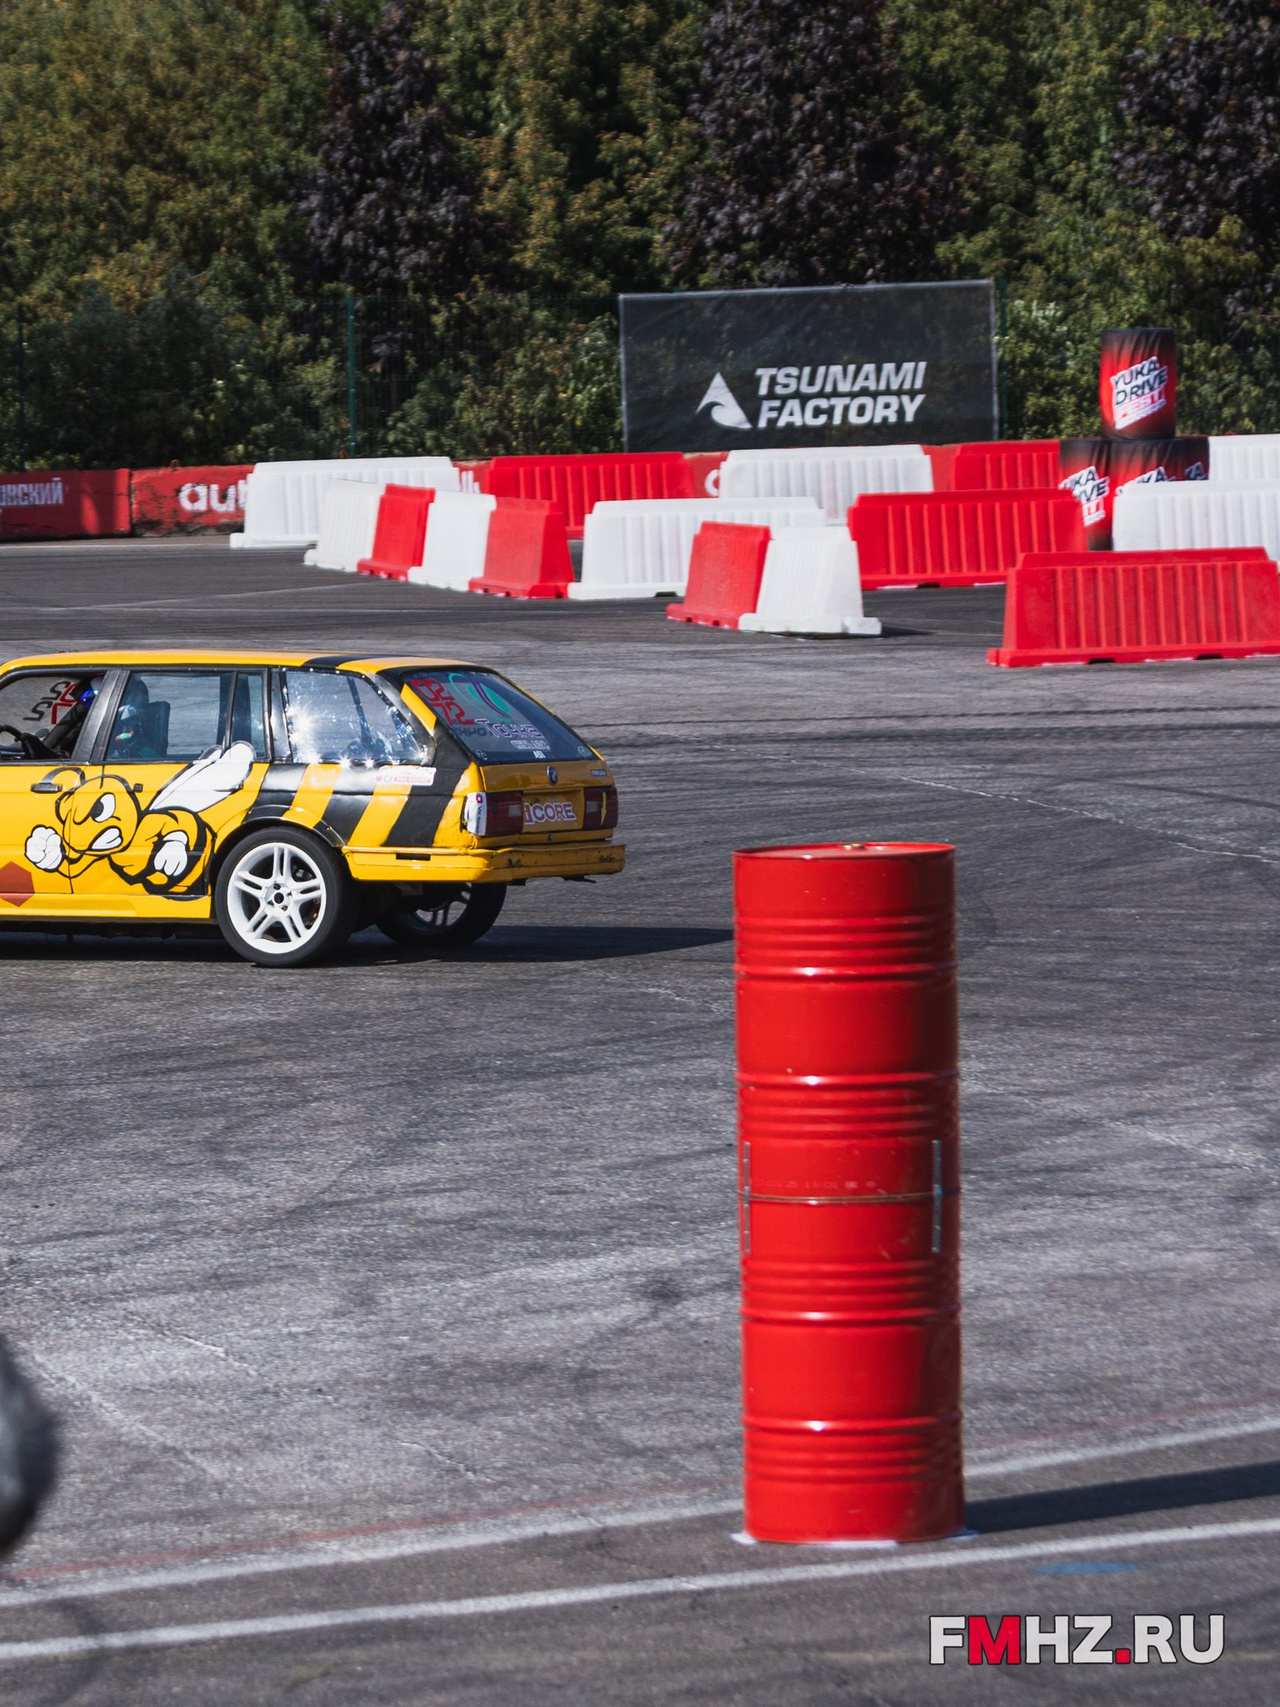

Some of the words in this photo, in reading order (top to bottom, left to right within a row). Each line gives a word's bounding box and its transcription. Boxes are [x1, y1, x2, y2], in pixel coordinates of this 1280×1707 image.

[755, 361, 928, 397] TSUNAMI
[1110, 357, 1159, 387] YUKA
[1115, 368, 1168, 405] DRIVE
[757, 393, 927, 429] FACTORY
